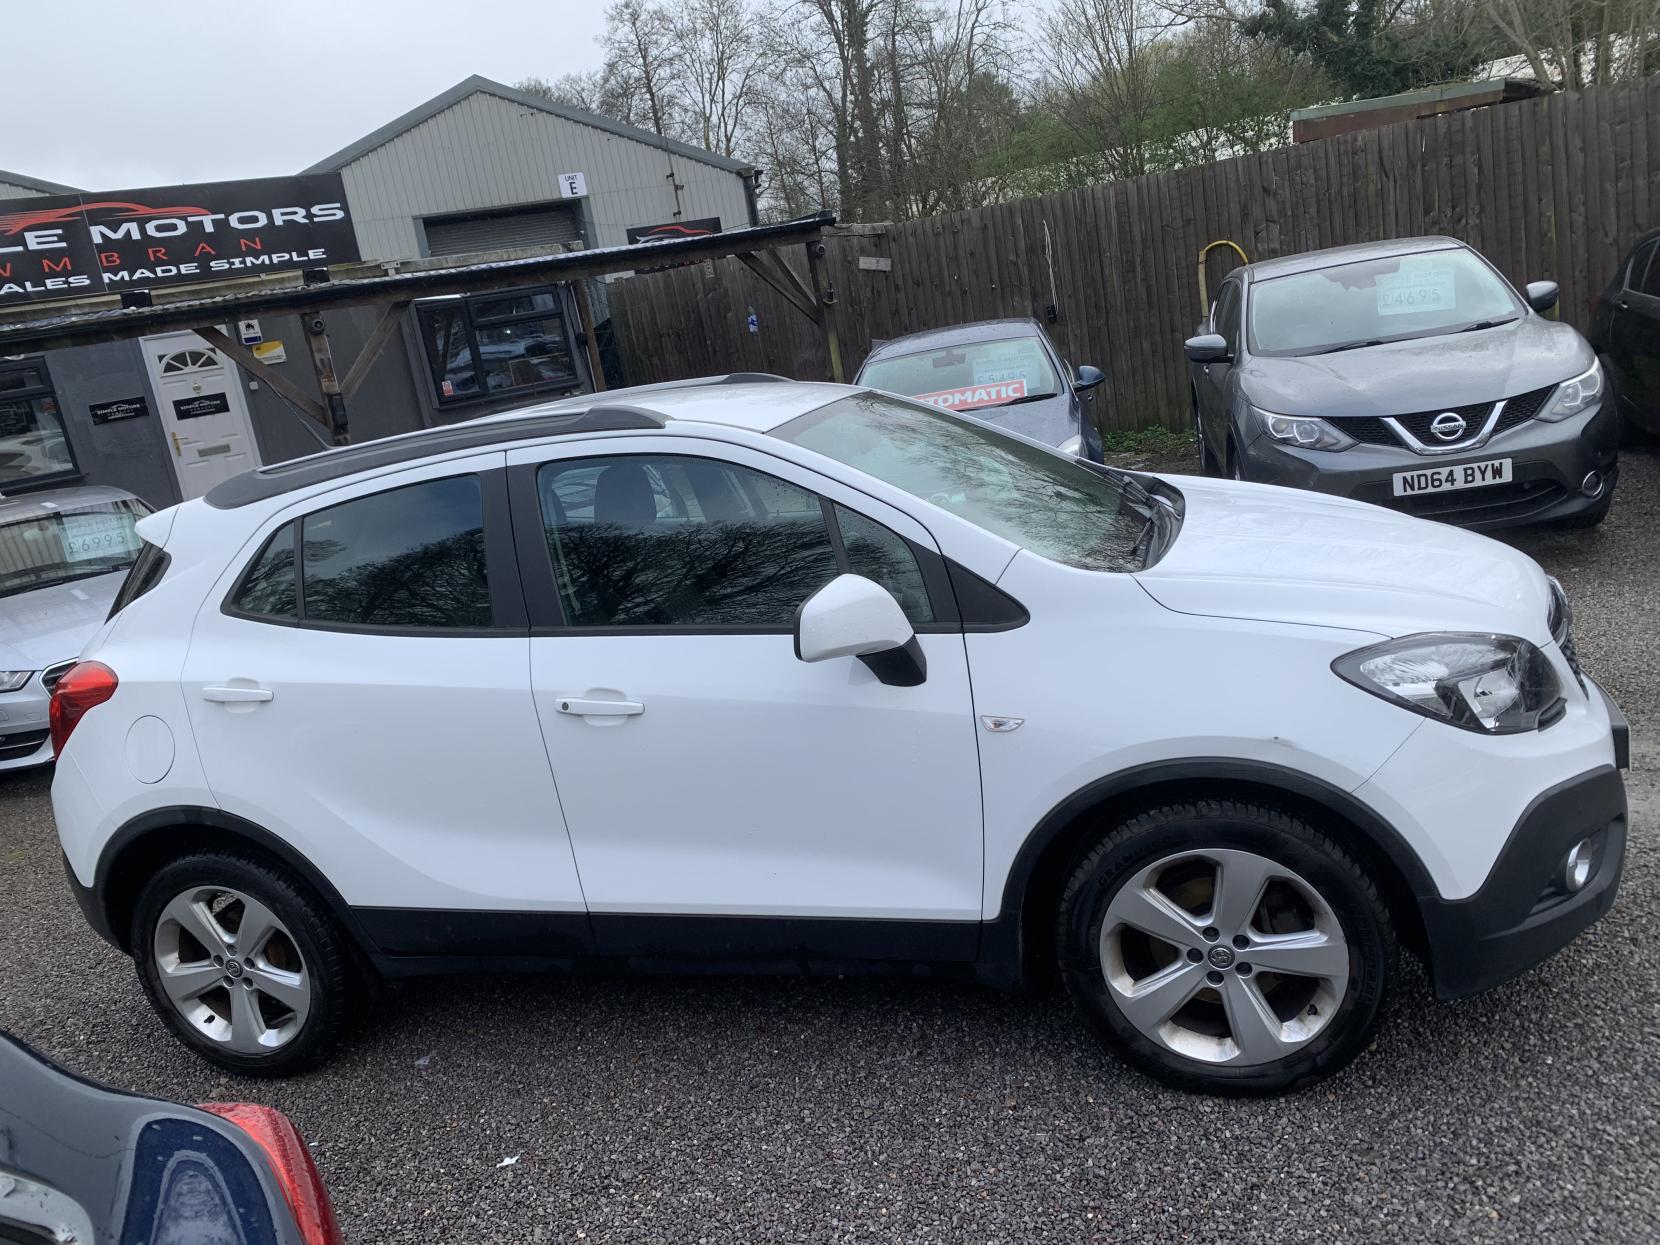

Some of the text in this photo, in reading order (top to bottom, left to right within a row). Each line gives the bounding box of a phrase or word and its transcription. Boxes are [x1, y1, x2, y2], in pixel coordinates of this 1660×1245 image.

[564, 174, 578, 182] UNIT
[569, 181, 579, 195] E
[89, 203, 345, 244] MOTORS
[102, 262, 200, 283] MADE
[209, 248, 327, 272] SIMPLE
[922, 384, 1020, 407] TOMATIC
[1433, 422, 1464, 431] NISSAN
[1402, 462, 1503, 493] ND64 BYW
[68, 532, 125, 554] £6995
